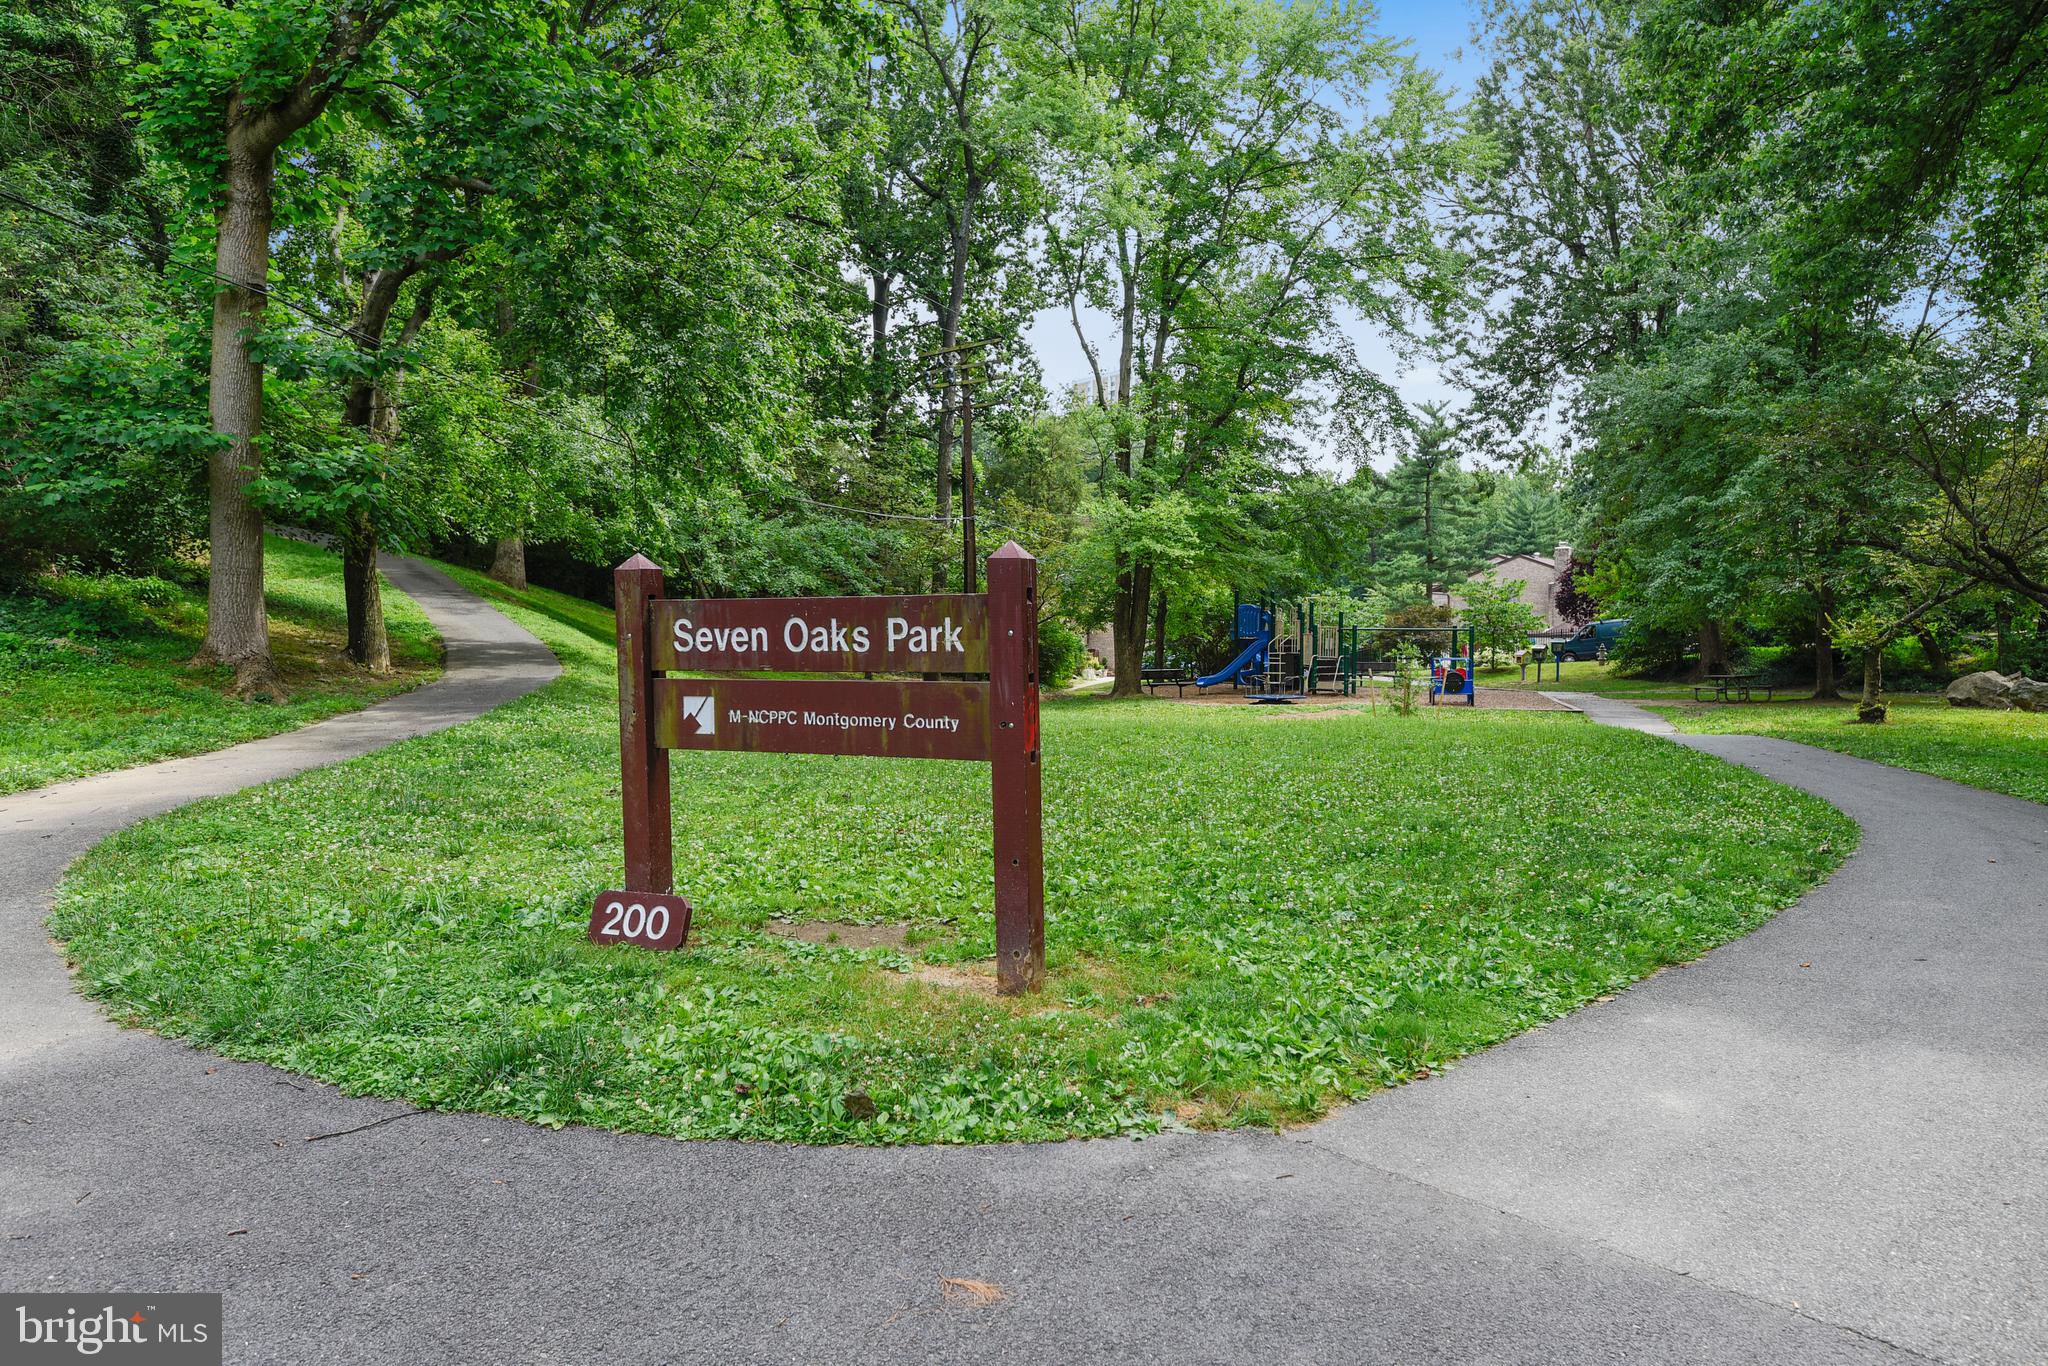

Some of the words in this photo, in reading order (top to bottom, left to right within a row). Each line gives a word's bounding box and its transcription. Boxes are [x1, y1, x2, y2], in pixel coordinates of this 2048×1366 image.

[673, 618, 768, 653] Seven
[784, 617, 870, 653] Oaks
[887, 617, 965, 653] Park
[728, 709, 797, 726] M-NCPPC
[803, 711, 897, 730] Montgomery
[903, 713, 960, 733] County
[601, 901, 670, 940] 200
